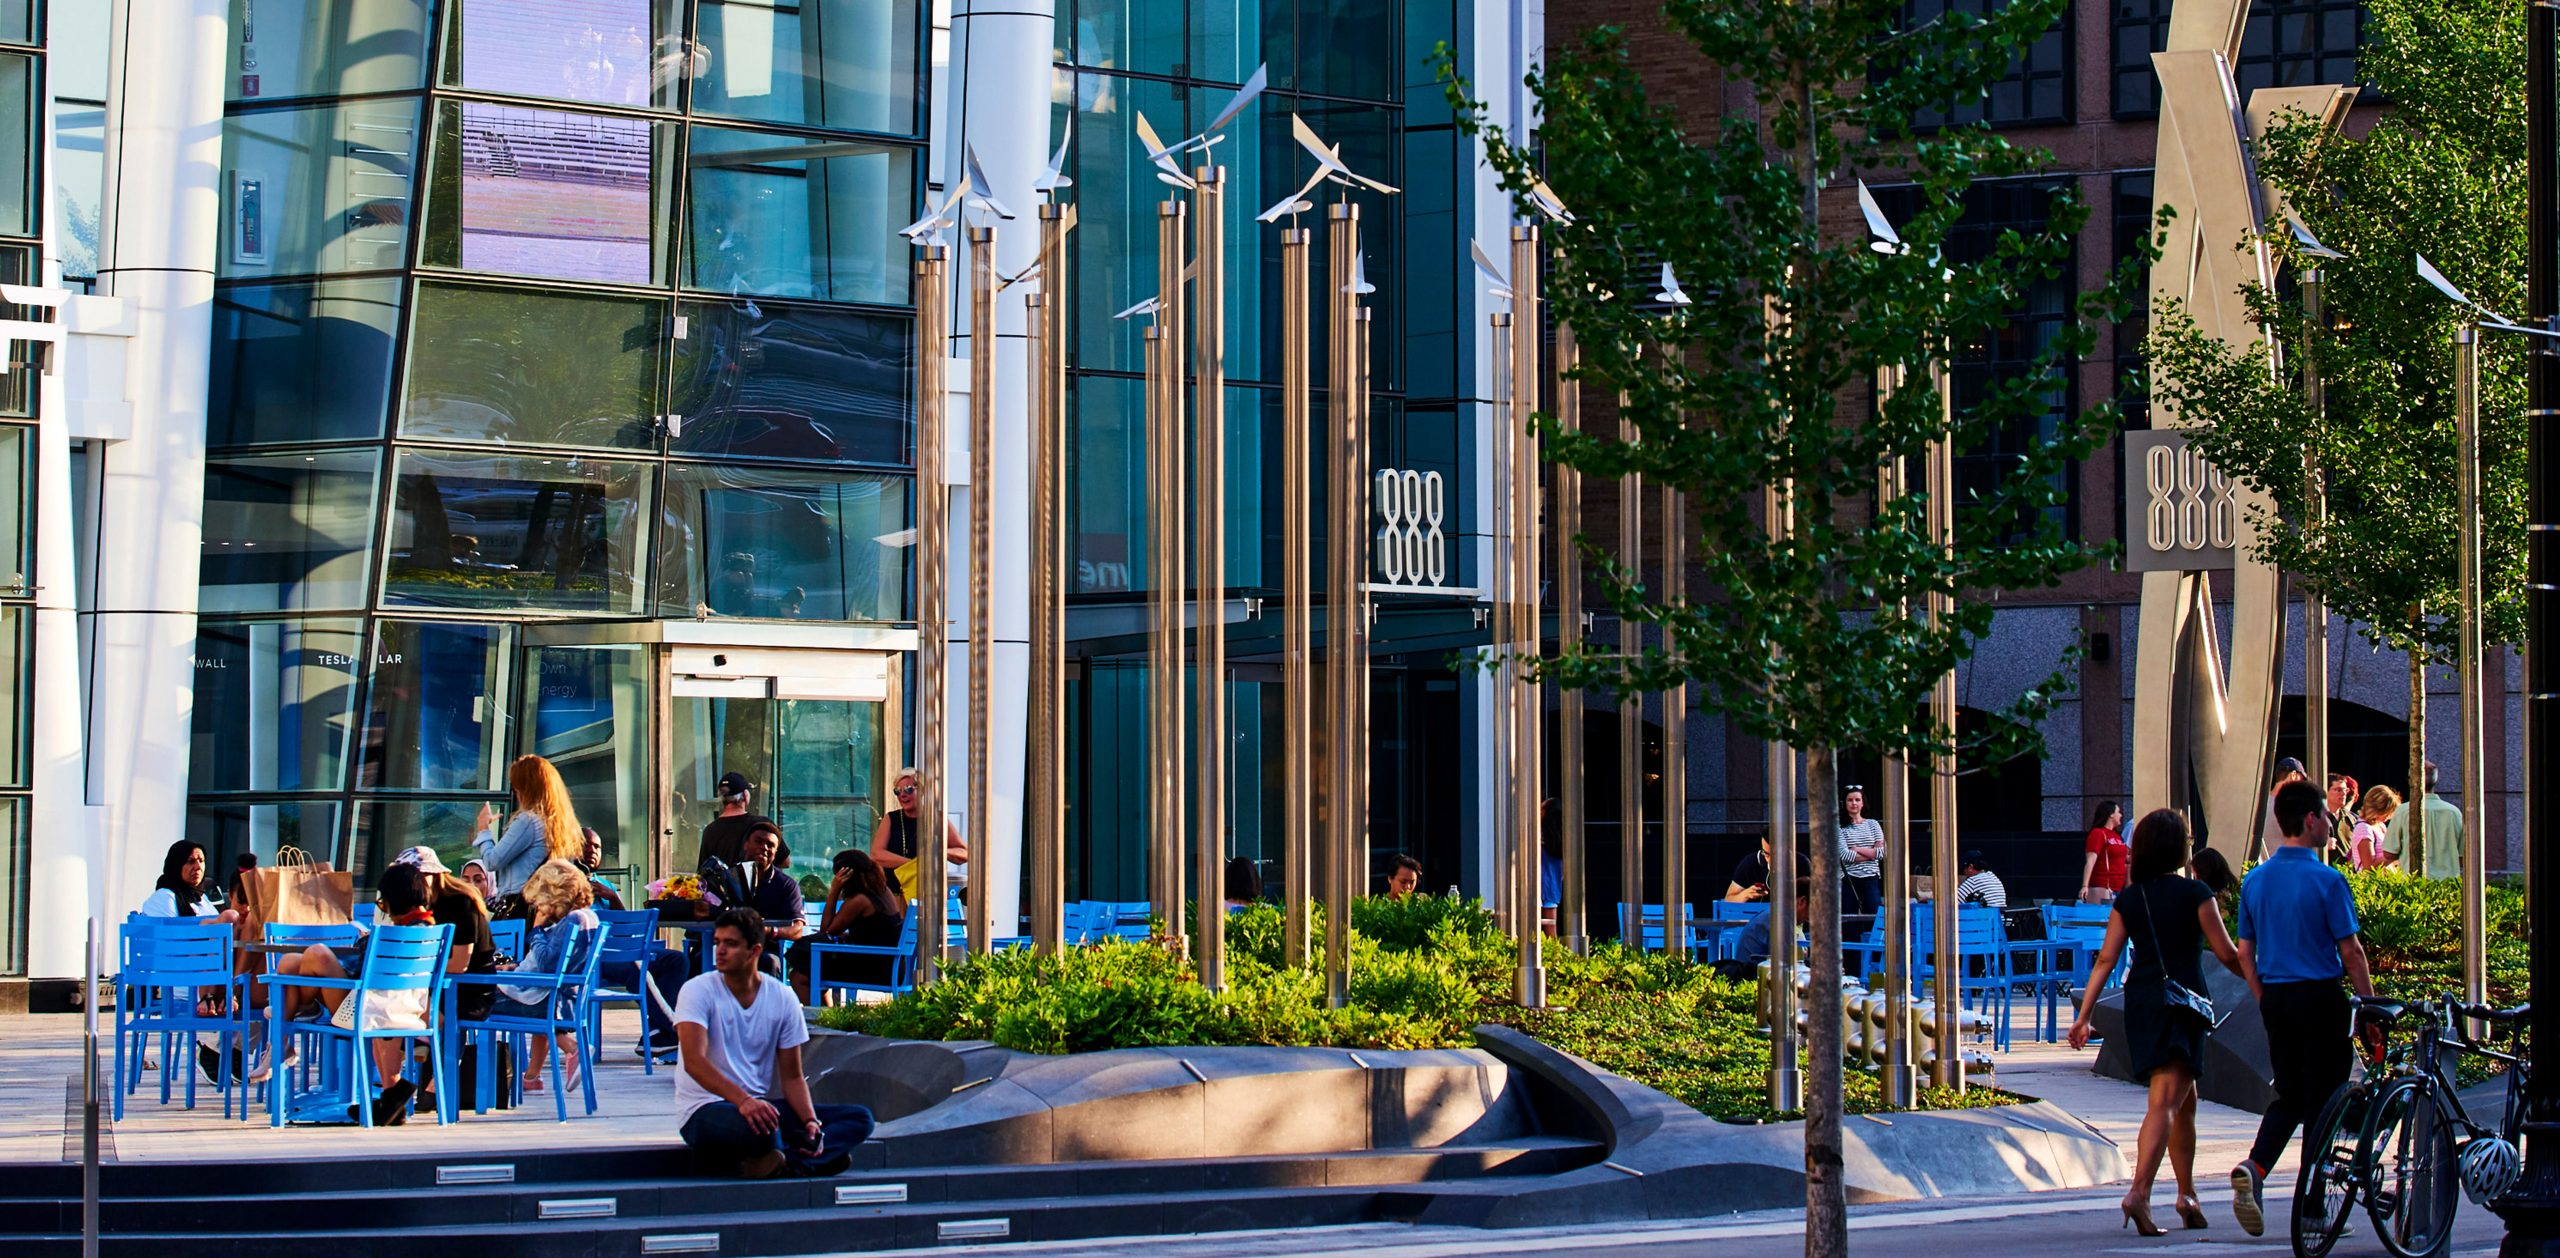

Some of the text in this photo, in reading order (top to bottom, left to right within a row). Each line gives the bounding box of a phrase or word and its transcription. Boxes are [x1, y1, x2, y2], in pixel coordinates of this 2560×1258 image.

[1382, 468, 1445, 582] 888
[2146, 445, 2236, 551] 888
[378, 654, 402, 664] LAR
[539, 685, 577, 698] nergy
